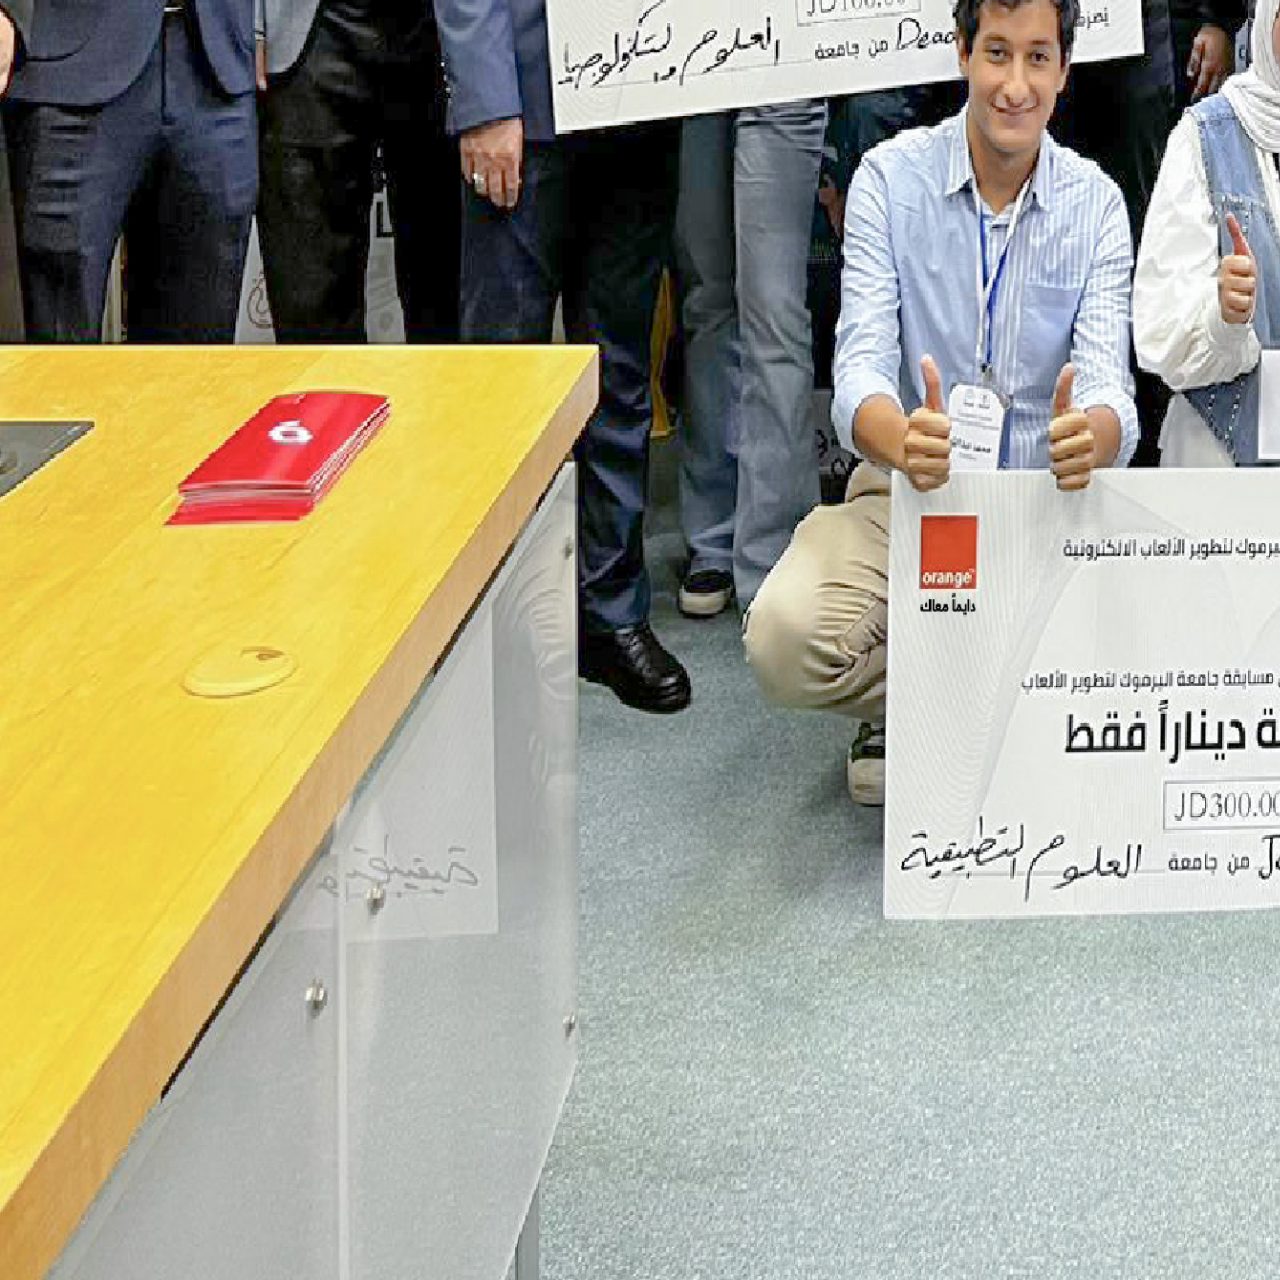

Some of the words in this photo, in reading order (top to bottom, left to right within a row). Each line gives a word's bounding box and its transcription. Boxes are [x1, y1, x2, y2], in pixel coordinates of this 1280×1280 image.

[814, 41, 860, 61] جامعة
[868, 38, 889, 59] من
[1189, 537, 1233, 560] لتطوير
[922, 571, 973, 589] orange
[920, 598, 949, 613] معاك
[1071, 671, 1117, 694] لتطوير
[1119, 672, 1173, 693] اليرموك
[1177, 671, 1219, 690] جامعة
[1223, 668, 1273, 689] مسابقة
[1065, 710, 1146, 753] فقط
[1168, 850, 1218, 876] جامعة
[1226, 853, 1250, 876] من
